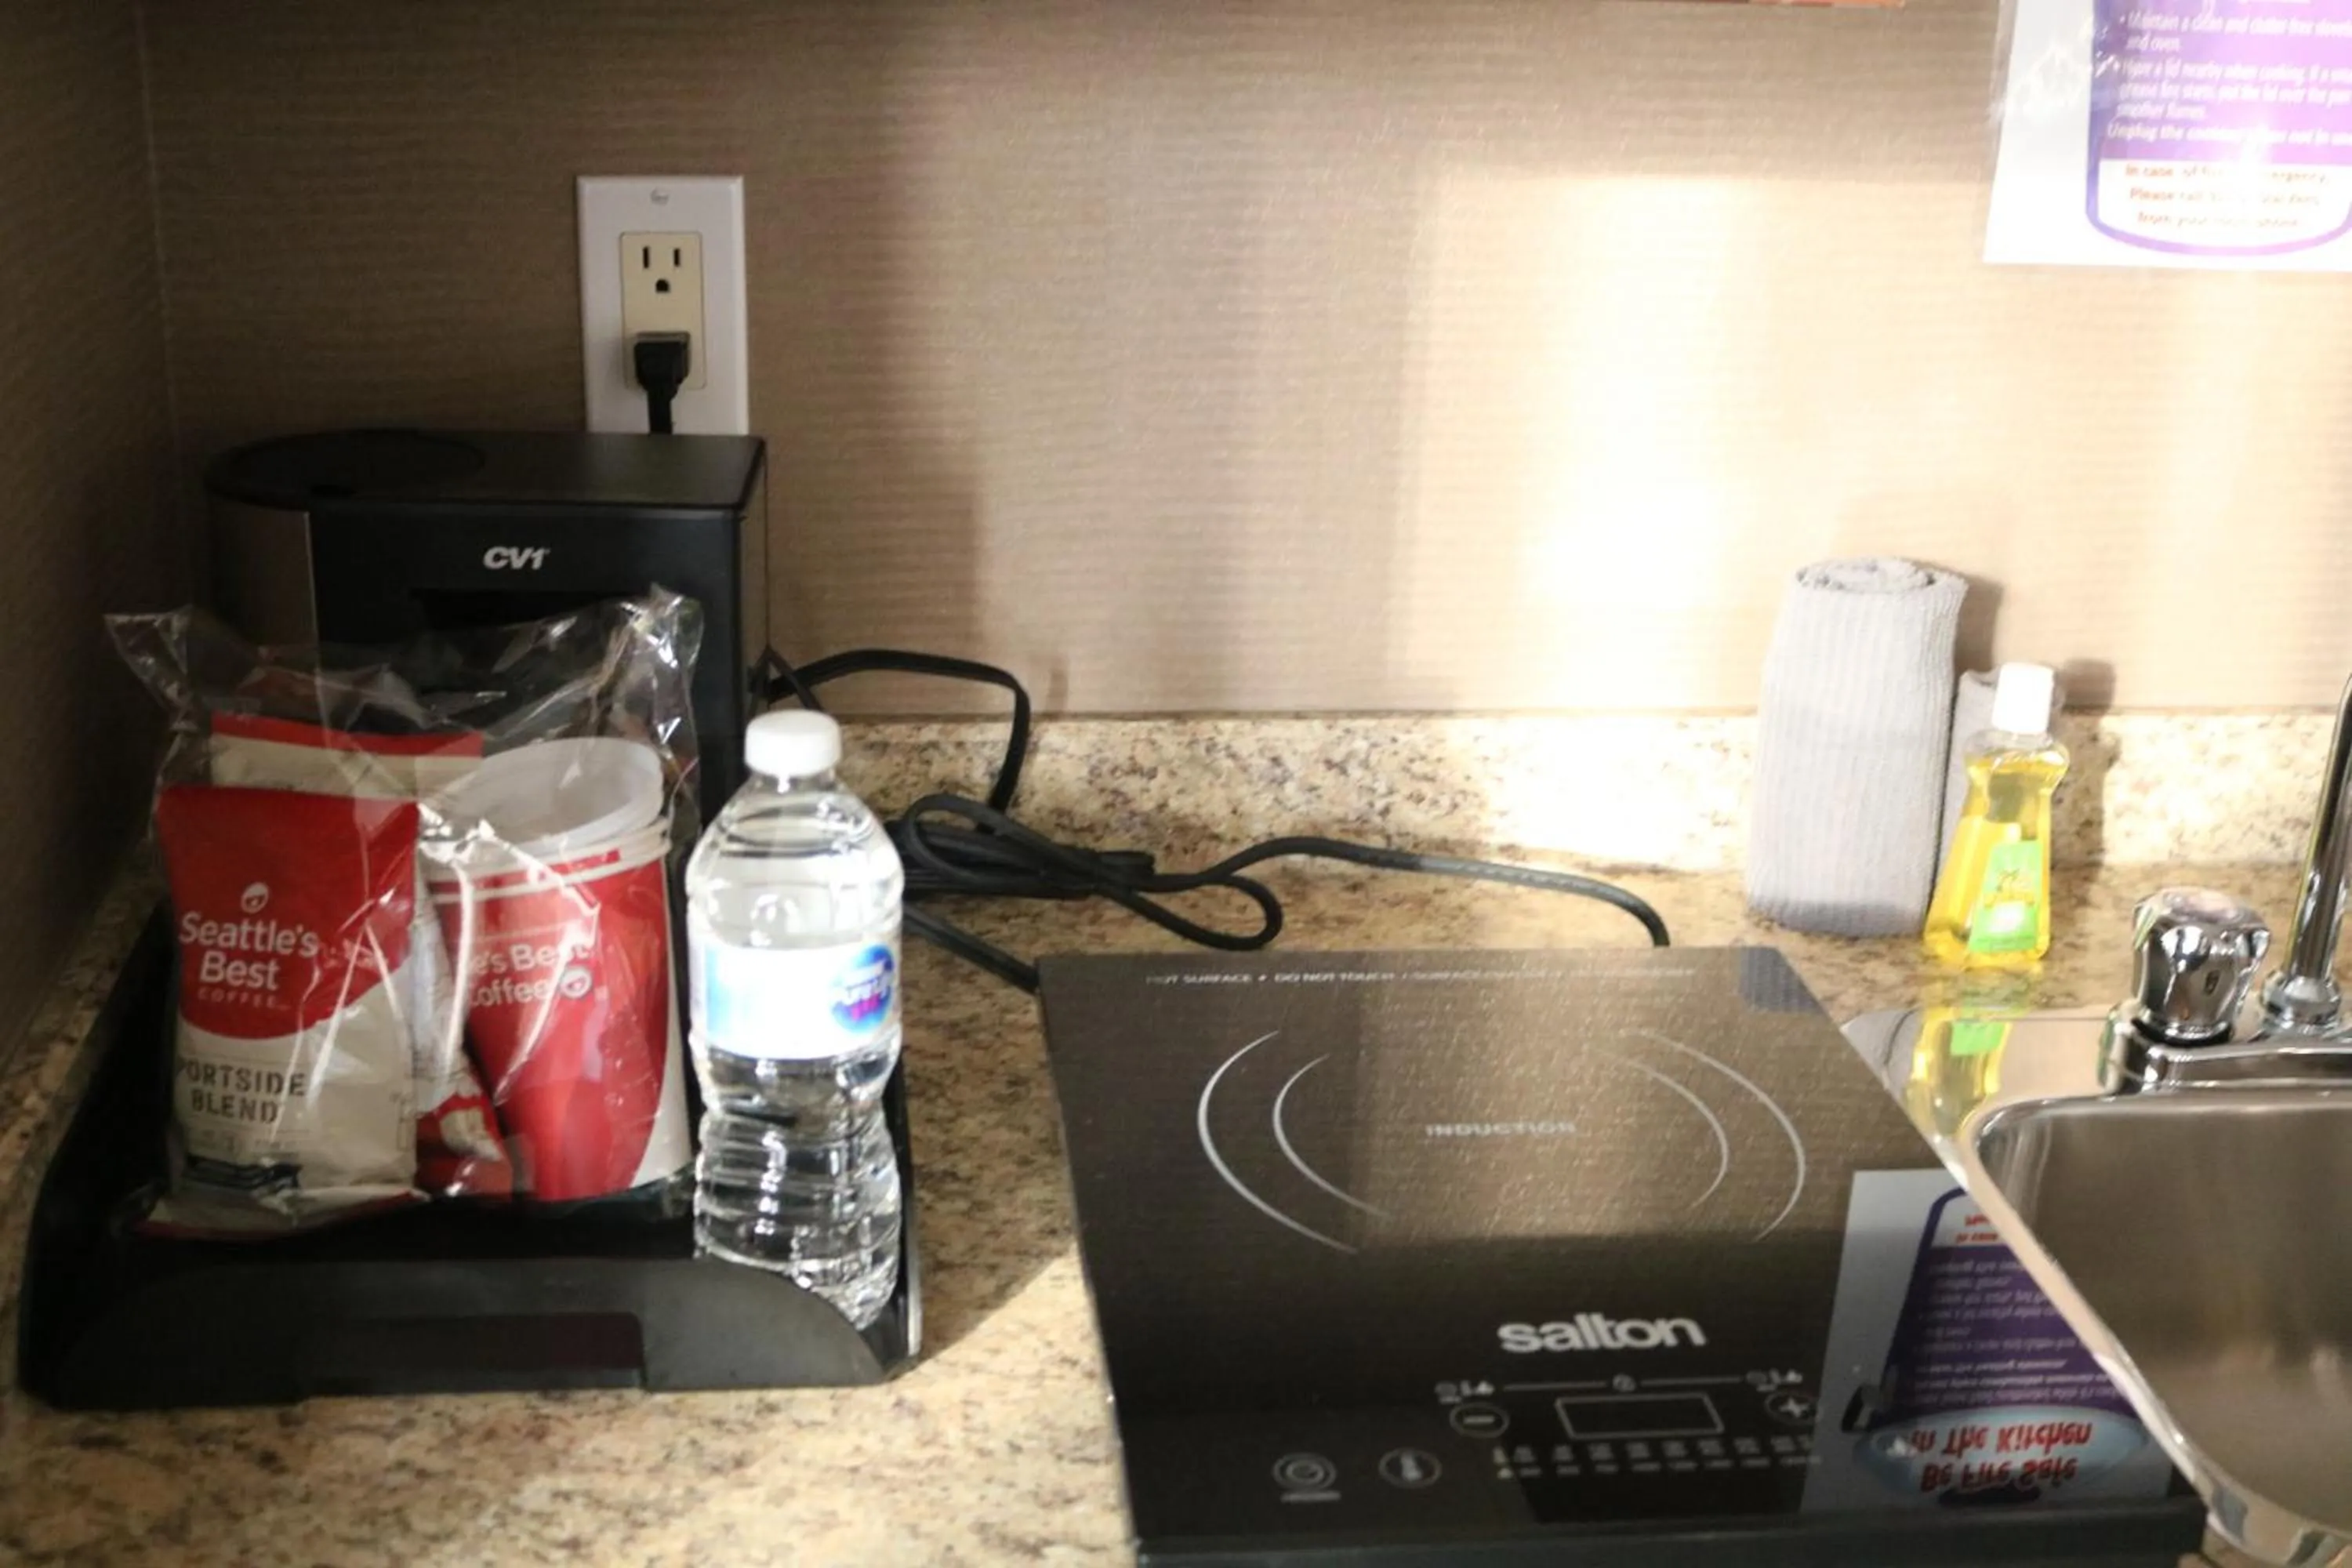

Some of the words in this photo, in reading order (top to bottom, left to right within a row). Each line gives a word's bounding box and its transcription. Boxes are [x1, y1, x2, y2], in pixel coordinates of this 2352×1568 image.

[179, 911, 319, 957] Seattle's
[199, 949, 281, 992] Best
[472, 977, 554, 1007] offee
[191, 1088, 278, 1124] BLEND
[1425, 1122, 1577, 1137] INDUCTION
[1497, 1312, 1707, 1353] salton
